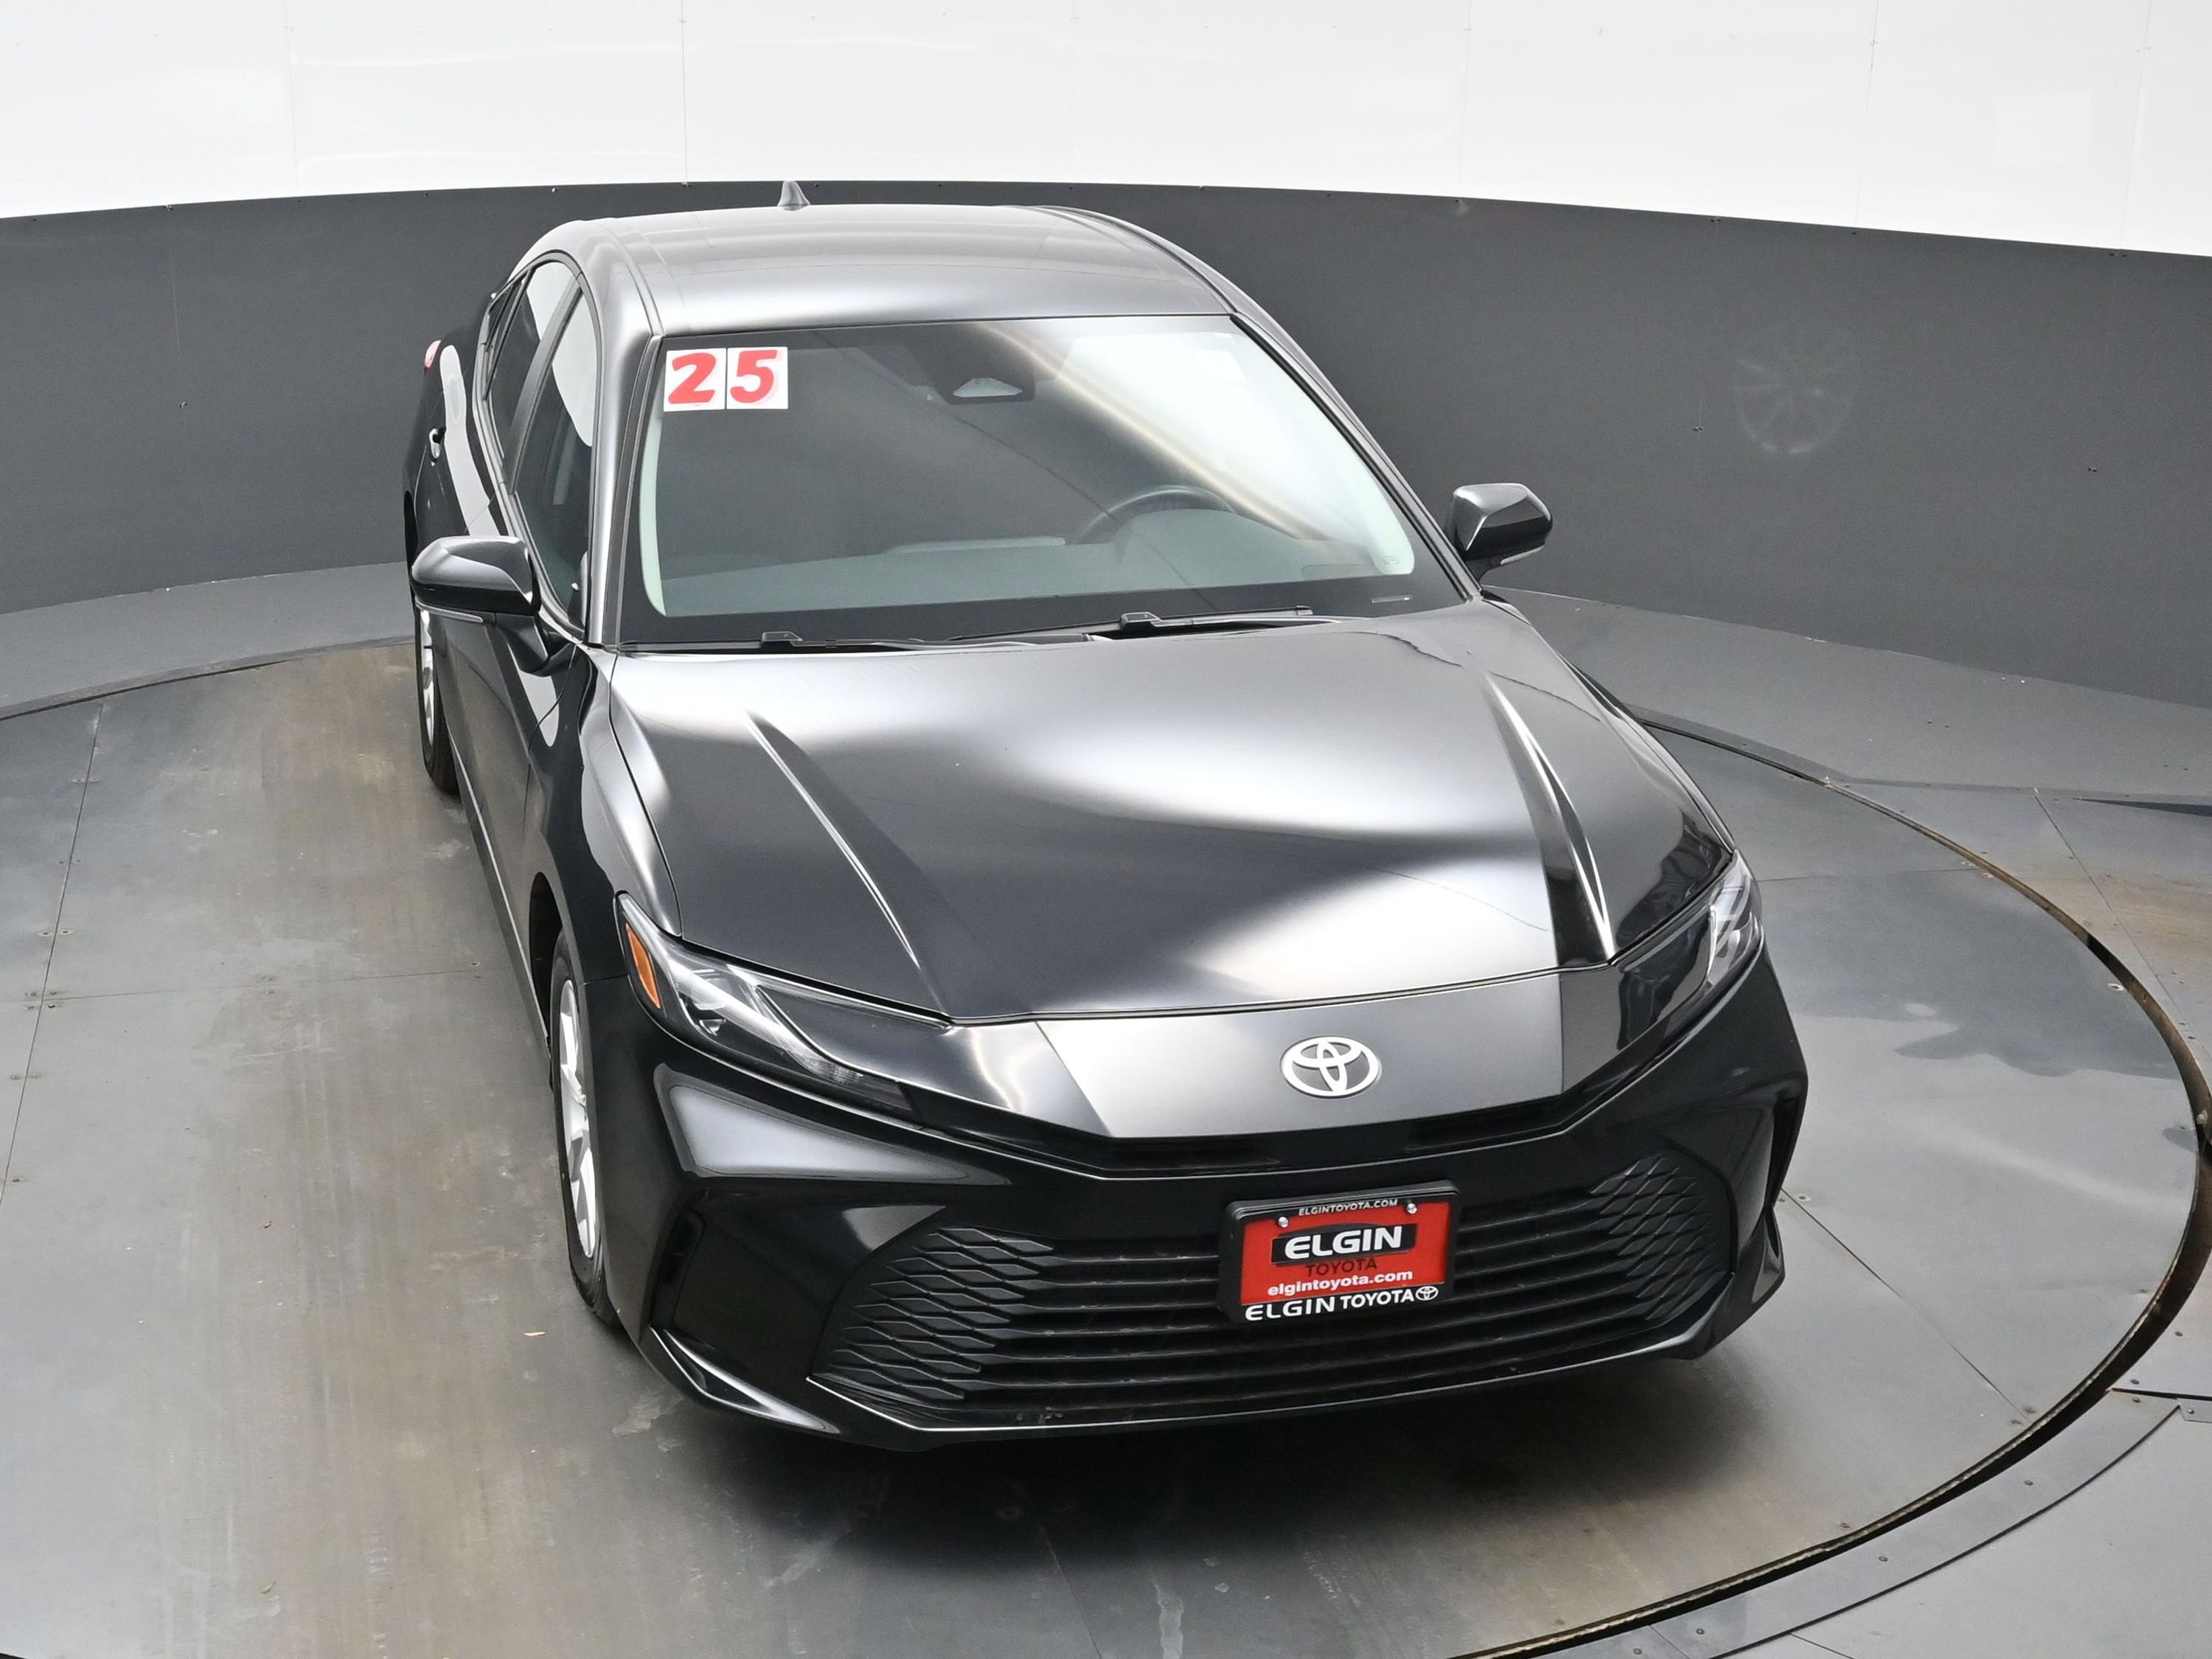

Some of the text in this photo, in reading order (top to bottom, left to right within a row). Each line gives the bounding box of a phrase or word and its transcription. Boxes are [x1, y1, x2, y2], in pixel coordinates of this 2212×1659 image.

[668, 349, 777, 404] 25
[1298, 1198, 1398, 1216] ELGINTOYOTA.COM
[1284, 1226, 1402, 1259] ELGIN
[1306, 1258, 1377, 1277] TOYOTA
[1267, 1270, 1413, 1296] elgintoyota.com
[1245, 1289, 1415, 1321] ELGIN TOYOTA
